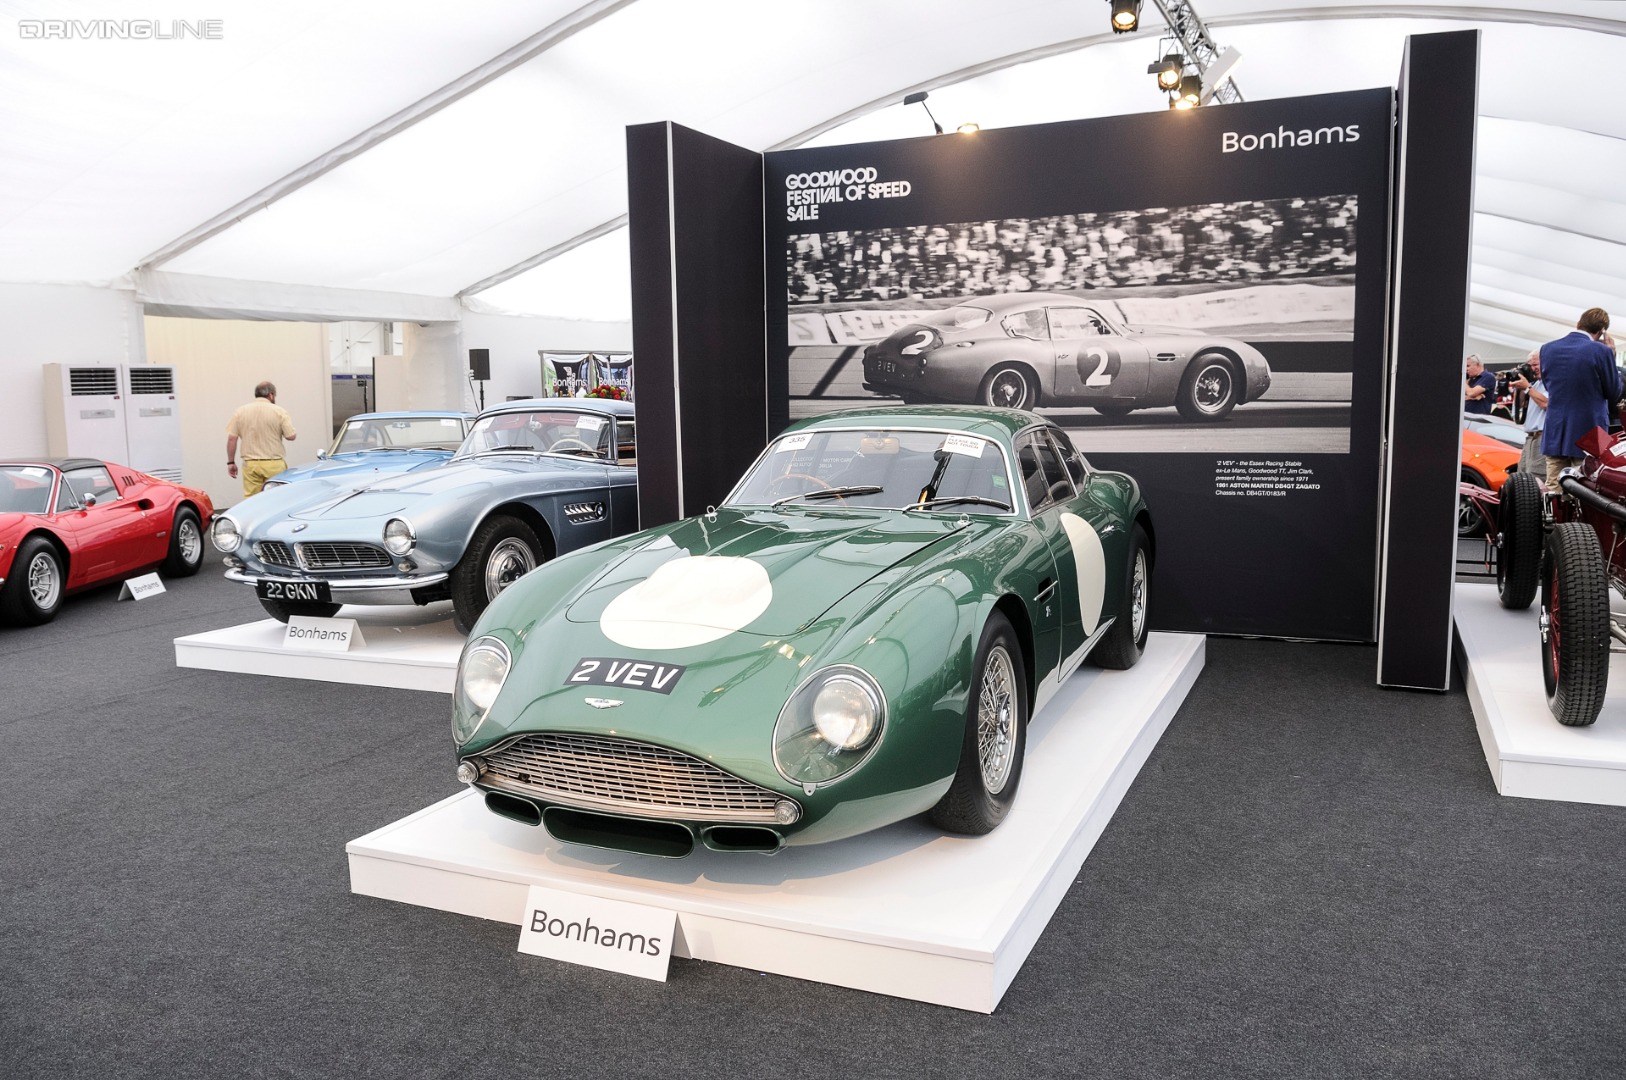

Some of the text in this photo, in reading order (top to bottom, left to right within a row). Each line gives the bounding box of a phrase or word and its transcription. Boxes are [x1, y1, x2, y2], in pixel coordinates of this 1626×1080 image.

[1222, 124, 1361, 153] Bonhams
[785, 166, 878, 190] GOODWOOD
[786, 180, 912, 206] FESTIVAL OF SPEED
[786, 204, 819, 222] SALE
[901, 330, 934, 355] 2
[1085, 346, 1112, 387] 2
[133, 581, 160, 594] Bonhams
[266, 581, 318, 600] 22 GKN
[289, 626, 348, 641] Bonhams
[570, 660, 679, 689] 2 VEV
[530, 909, 662, 957] Bonhams
